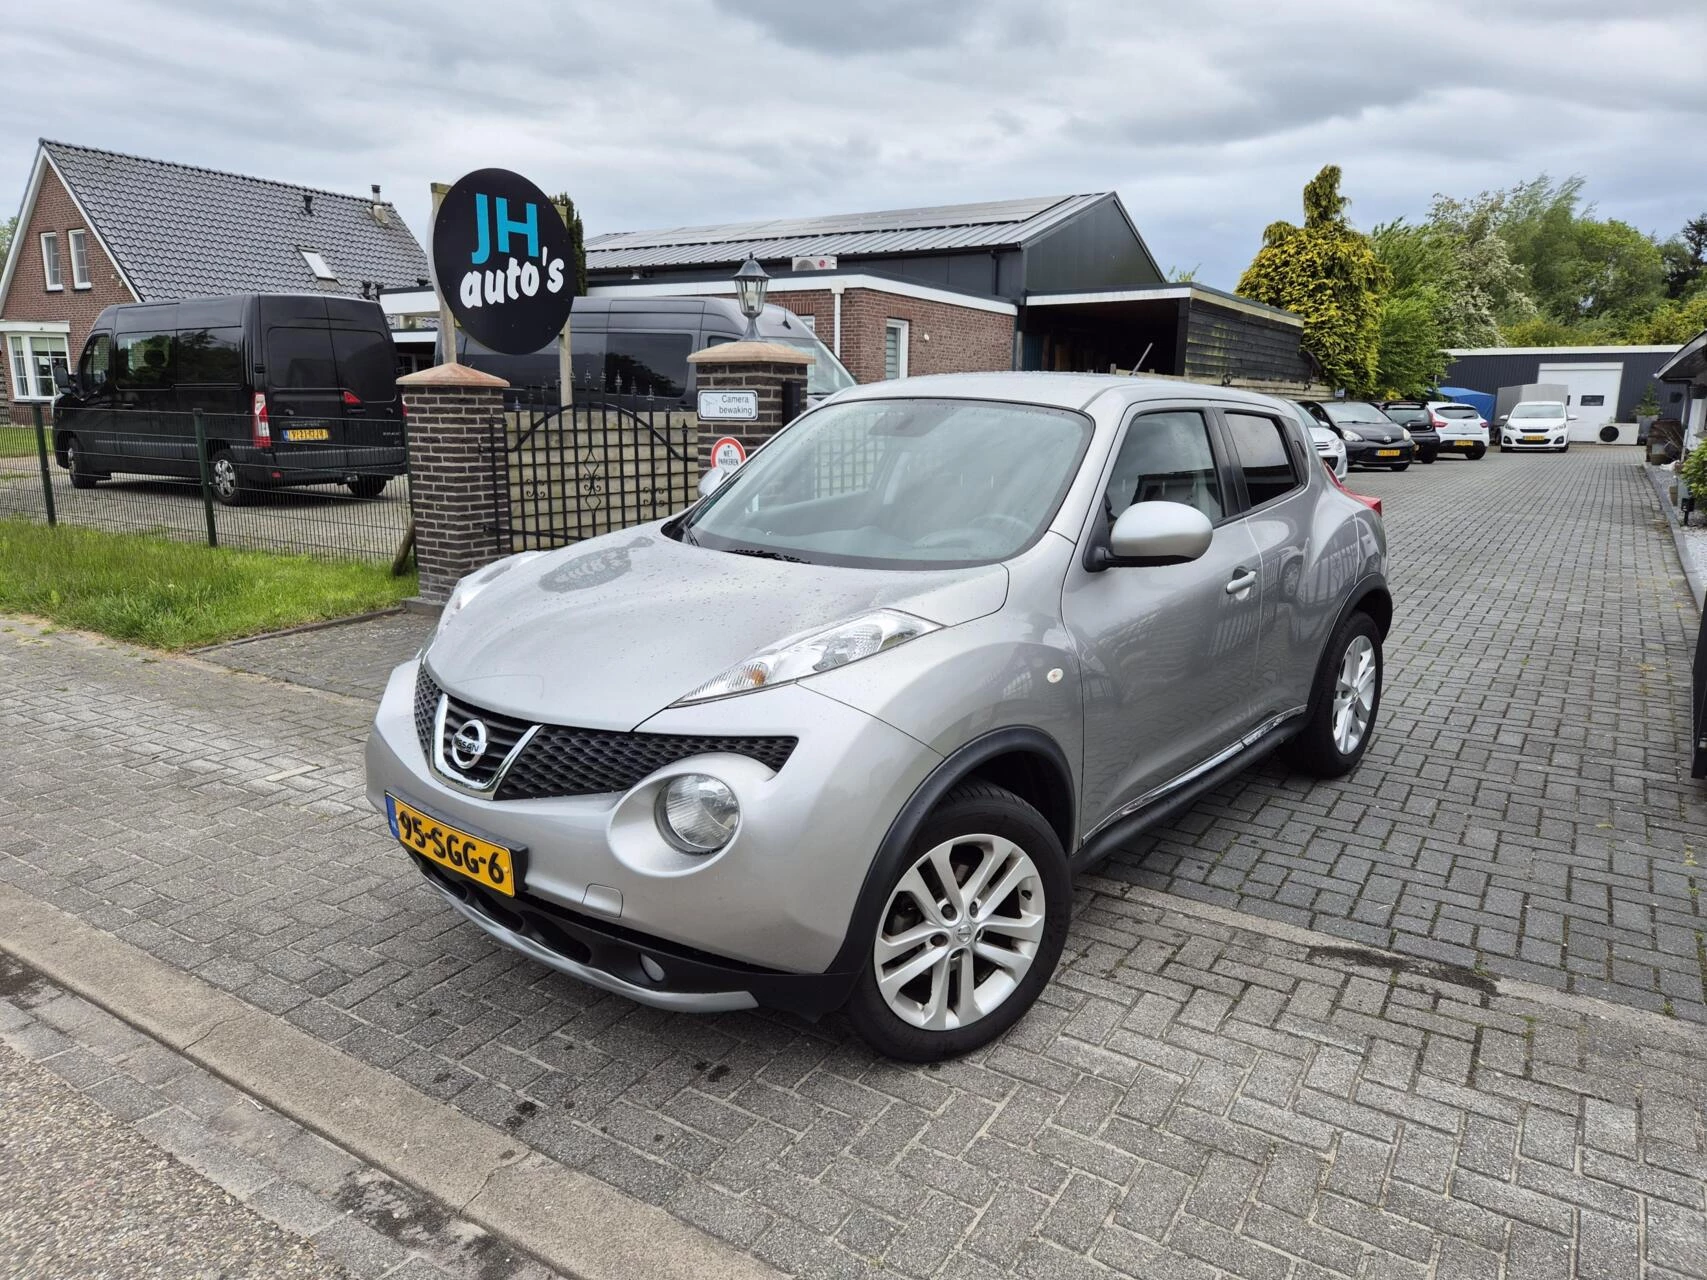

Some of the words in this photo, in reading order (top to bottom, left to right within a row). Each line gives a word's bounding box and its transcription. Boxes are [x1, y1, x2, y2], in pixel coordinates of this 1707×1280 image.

[471, 192, 540, 265] JH
[459, 246, 565, 310] auto's
[719, 406, 753, 417] bewaking
[721, 394, 749, 404] Camera
[399, 810, 505, 884] 95-SGG-6
